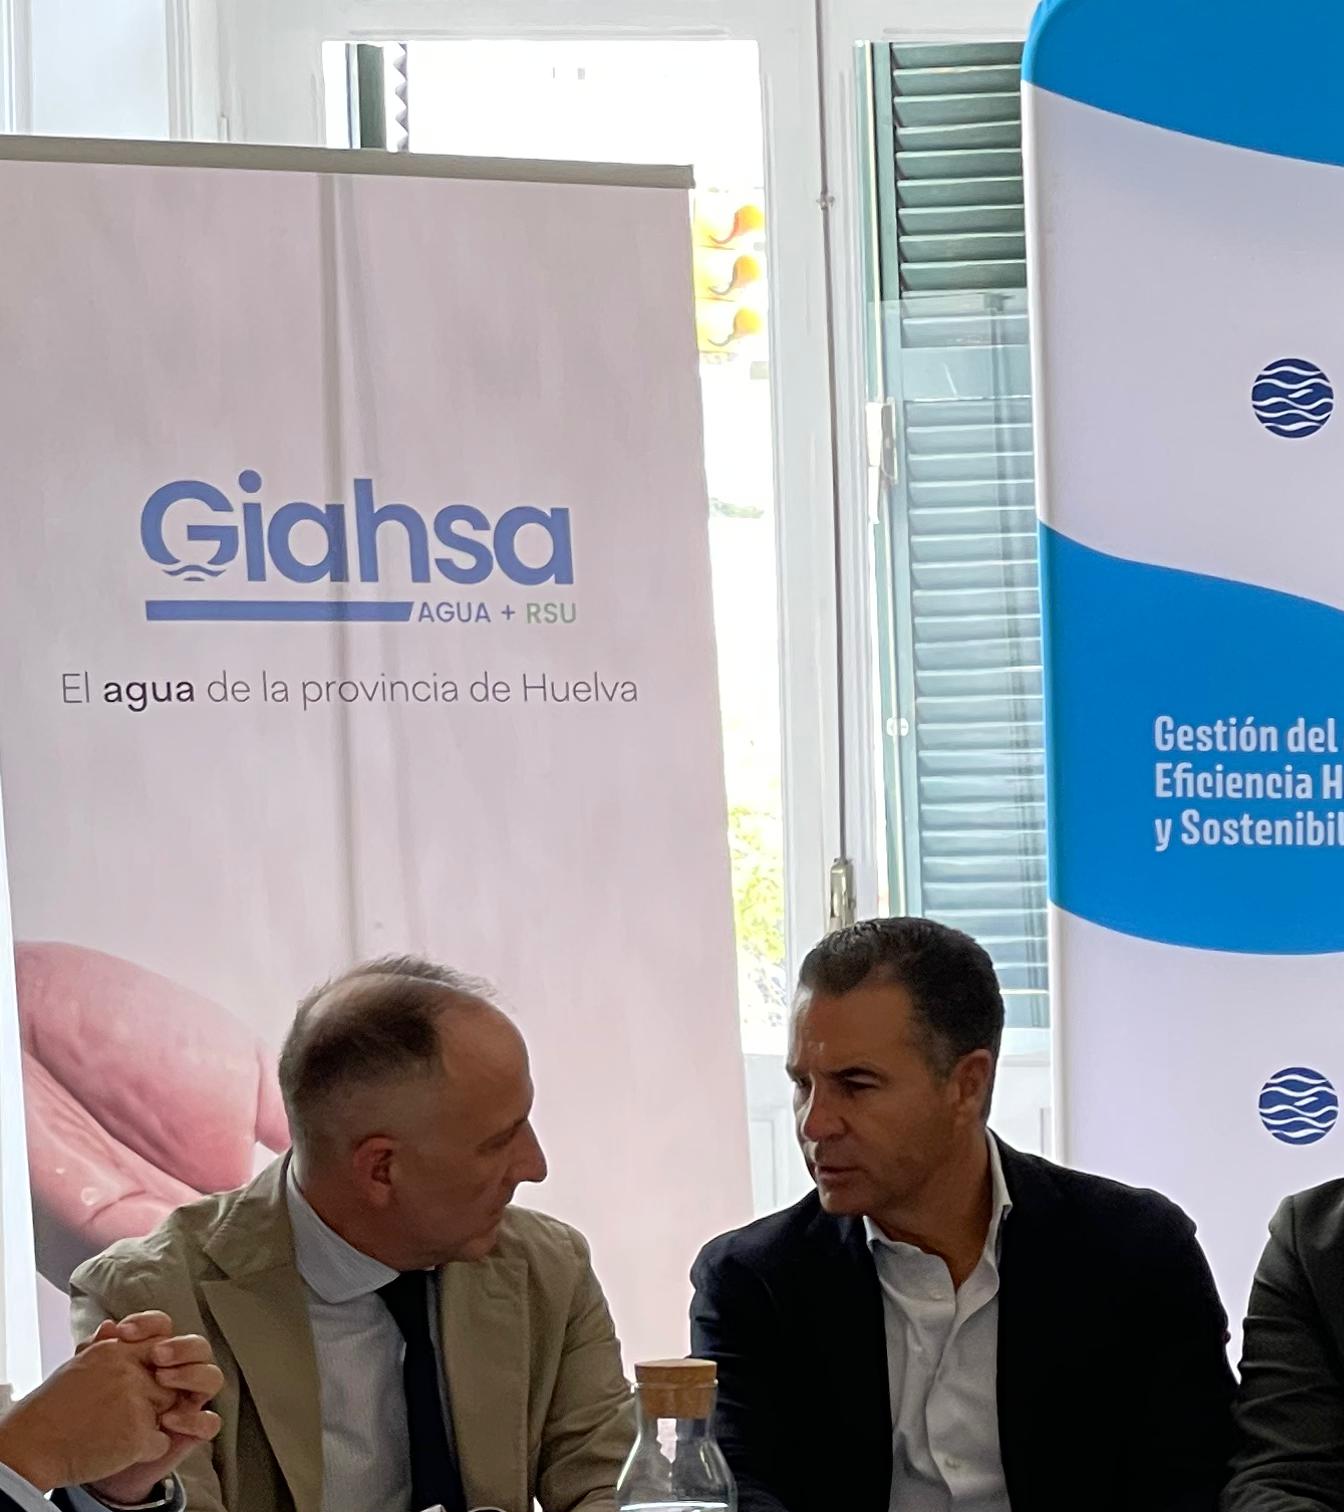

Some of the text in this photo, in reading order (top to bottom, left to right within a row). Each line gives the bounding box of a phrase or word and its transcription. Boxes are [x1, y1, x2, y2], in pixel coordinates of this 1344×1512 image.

[141, 470, 574, 585] Giahsa
[418, 602, 491, 624] AGUA
[526, 602, 577, 624] RSU
[62, 672, 637, 711] El agua de la provincia de Huelva
[1154, 714, 1278, 753] Gestión
[1286, 716, 1337, 753] del
[1154, 762, 1313, 800] Eficiencia
[1154, 817, 1171, 853] y
